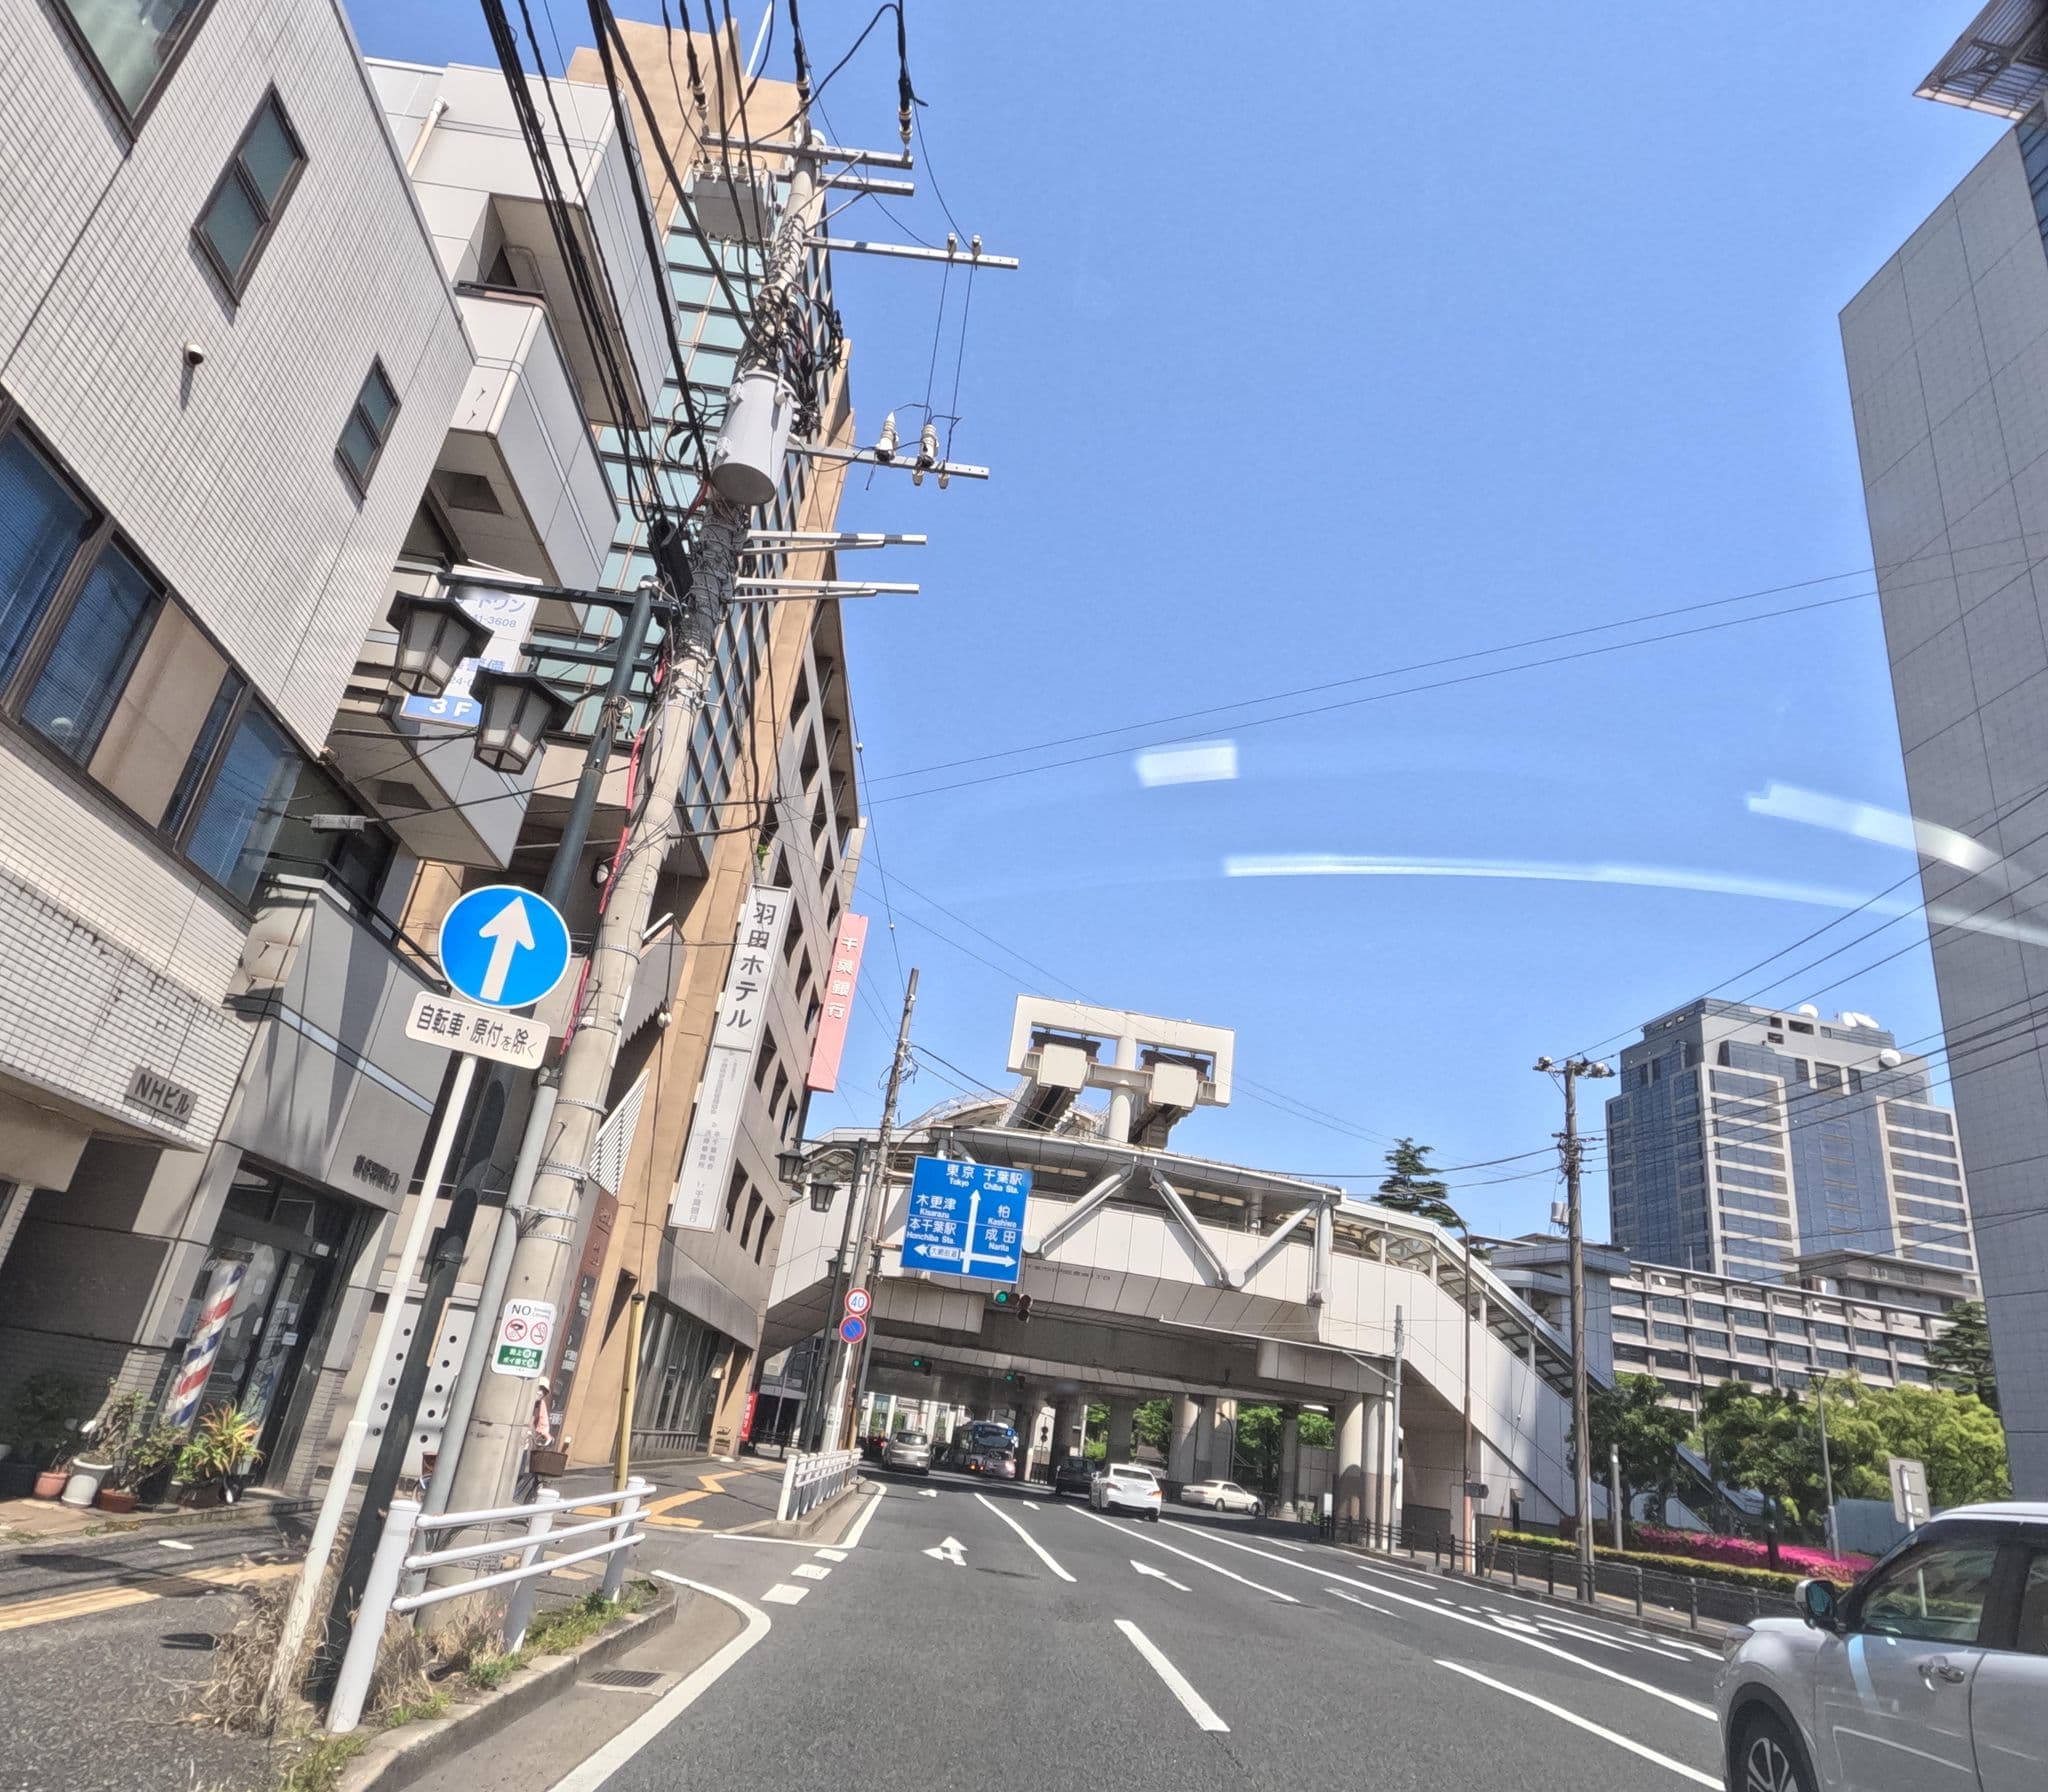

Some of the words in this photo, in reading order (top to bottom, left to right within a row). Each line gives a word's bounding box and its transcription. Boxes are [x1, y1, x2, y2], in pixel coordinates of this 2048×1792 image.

[726, 902, 776, 1029] 羽田ホテル
[827, 937, 857, 1019] 千葉銀行
[416, 1003, 538, 1059] 自転車・原付を除く
[134, 1073, 190, 1115] NHビル
[946, 1163, 975, 1179] 東京
[983, 1168, 1023, 1186] 千葉駅
[949, 1177, 970, 1188] Tokyo
[983, 1182, 1003, 1192] Chiba
[916, 1194, 957, 1211] 木更津
[920, 1207, 950, 1219] Kisarazu
[997, 1204, 1011, 1219] 柏
[909, 1218, 957, 1236] 本千葉駅
[987, 1217, 1017, 1229] Kashiwa
[985, 1229, 1016, 1244] 成田
[988, 1242, 1010, 1252] Narita
[850, 1295, 865, 1308] 40
[511, 1304, 532, 1316] NO
